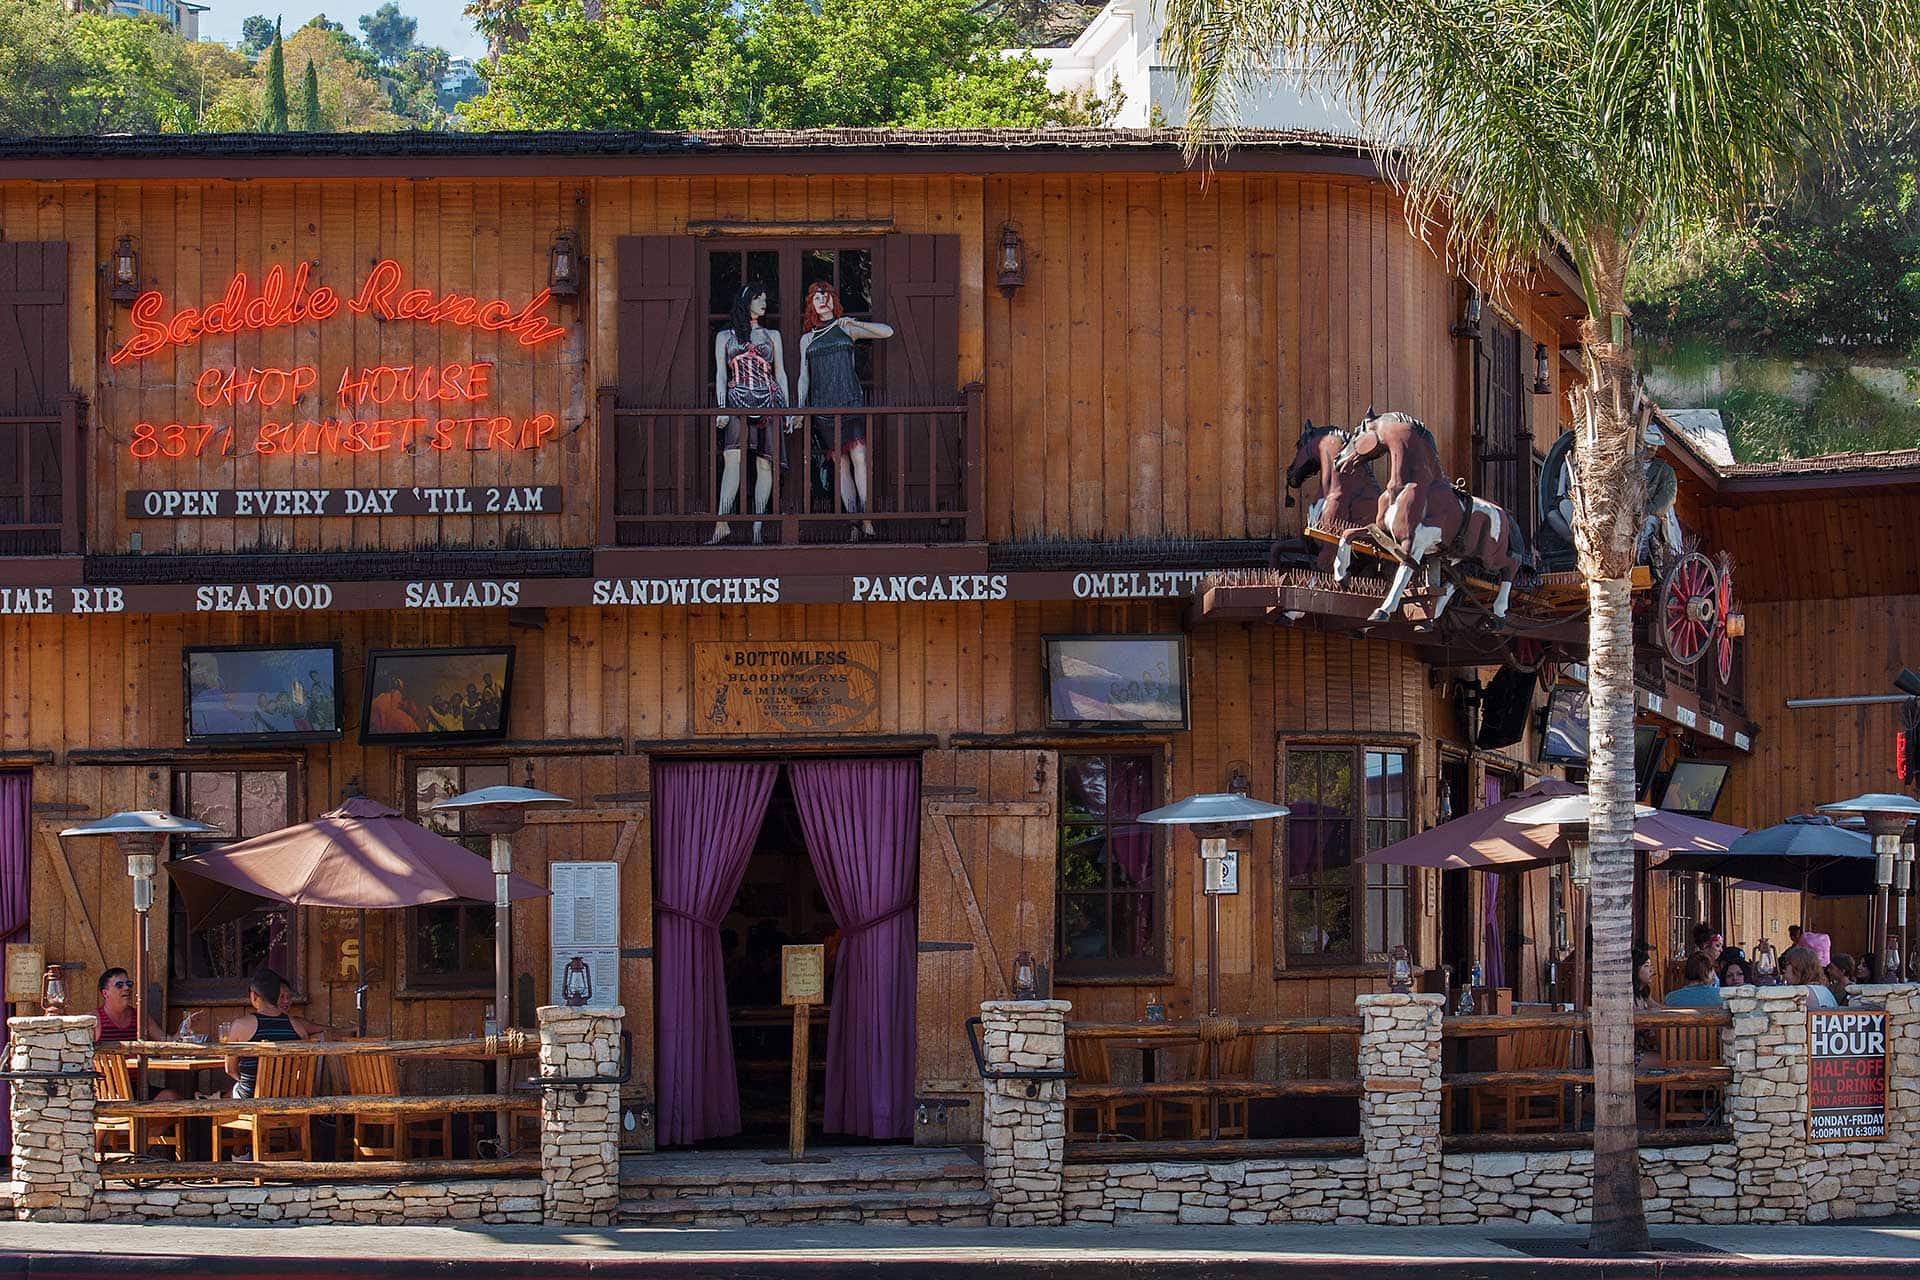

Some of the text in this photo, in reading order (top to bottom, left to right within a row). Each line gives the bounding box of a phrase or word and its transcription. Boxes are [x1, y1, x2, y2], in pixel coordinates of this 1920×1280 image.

[111, 259, 567, 364] Saddle Ranch
[195, 362, 494, 408] CHOP HOUSE
[129, 413, 557, 458] 8371 SUNSET STRIP
[144, 491, 219, 516] OPEN
[235, 490, 330, 515] EVERY
[344, 489, 398, 514] DAY
[485, 487, 544, 512] 2AM
[405, 581, 520, 607] SALADS
[592, 577, 780, 605] SANDWICHES
[851, 574, 1008, 602] PANCAKES
[1072, 571, 1222, 598] OMELETT
[0, 587, 124, 613] IME RIB
[196, 583, 332, 611] SEAFOOD
[735, 651, 847, 666] BOTTOMLESS
[728, 673, 848, 682] BLOODY MARYS
[742, 687, 831, 695] & MIMOSAS
[1812, 1014, 1885, 1032] HAPPY
[1811, 1032, 1885, 1055] HOUR
[1813, 1059, 1882, 1077] HALF-OFF
[1812, 1077, 1884, 1093] ALL DRINKS
[1811, 1094, 1884, 1105] AND APPETIZERS
[1810, 1126, 1884, 1138] 4:00PM TO 6:30PM
[1811, 1113, 1885, 1127] MONDAY-FRIDAY
